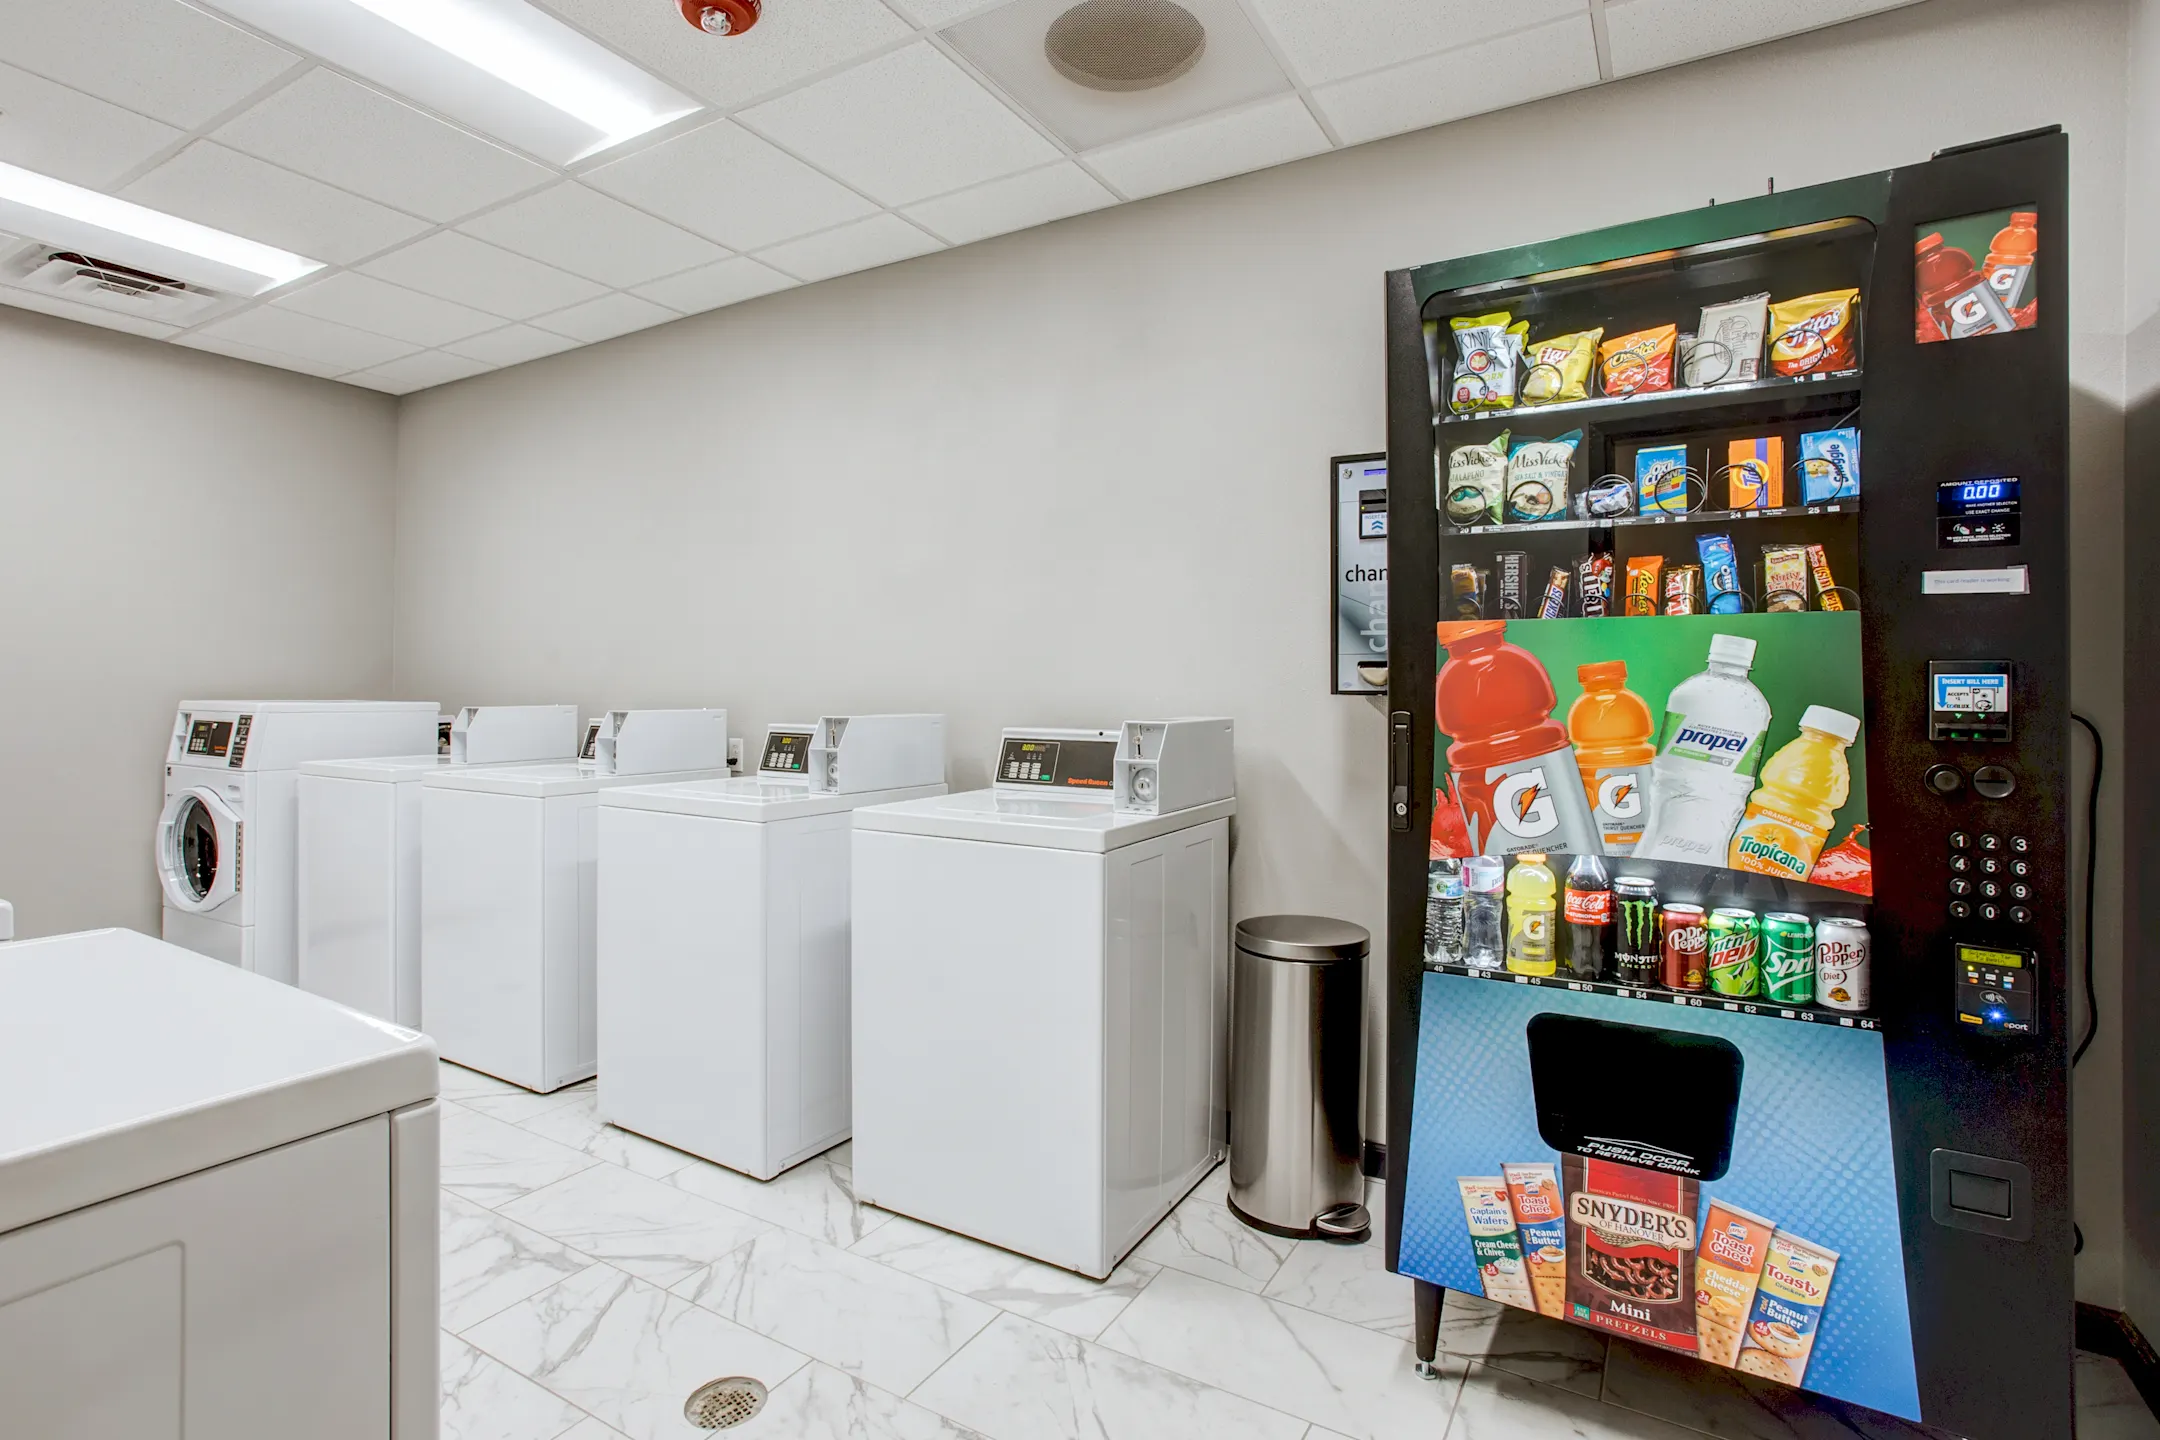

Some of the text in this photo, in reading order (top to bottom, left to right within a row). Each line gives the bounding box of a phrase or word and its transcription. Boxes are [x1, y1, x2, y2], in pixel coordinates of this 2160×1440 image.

[1989, 268, 2017, 290] G
[1951, 292, 1987, 324] G
[1785, 309, 1840, 348] Fritos
[1788, 361, 1799, 369] The
[1800, 345, 1838, 366] ORIGINAL
[1827, 443, 1849, 483] Snuggle
[1742, 462, 1759, 486] Tide
[1675, 728, 1748, 752] propel
[1088, 778, 1108, 786] Queen
[1493, 766, 1560, 838] G
[1598, 773, 1642, 819] G
[1762, 808, 1814, 832] ORANGE JUICE
[1956, 835, 2027, 851] 1 2 3
[1738, 836, 1806, 875] Tropicana
[1740, 855, 1764, 869] 100%
[1955, 858, 2026, 875] 4 5 6
[1565, 891, 1606, 910] Coca-Cola
[1956, 882, 2026, 898] 7 8 9
[1986, 906, 1995, 919] 0
[1523, 914, 1545, 940] G
[1686, 926, 1703, 938] Dr
[1818, 943, 1863, 967] Pepper
[1831, 941, 1851, 953] Dr
[1530, 977, 1541, 985] 45
[1823, 972, 1841, 980] Diet
[1582, 984, 1593, 992] 50
[1690, 998, 1702, 1006] 60
[1744, 1005, 1757, 1014] 62
[1801, 1012, 1814, 1021] 63
[1860, 1020, 1874, 1029] 64
[1577, 1145, 1701, 1175] TO RETRIEVE DRINK
[1587, 1142, 1690, 1167] PUSH DOOR
[1518, 1195, 1549, 1205] Toast
[1520, 1204, 1550, 1214] Chee
[1470, 1207, 1507, 1216] Captain's
[1472, 1215, 1509, 1226] Wafers
[1577, 1198, 1688, 1239] SNYDER'S
[1530, 1228, 1561, 1238] Peanut
[1599, 1219, 1664, 1242] OF HANOVER
[1474, 1240, 1520, 1250] Cream Cheese
[1531, 1237, 1560, 1246] Butter
[1713, 1230, 1754, 1256] Toast
[1477, 1248, 1506, 1257] & Chives
[1710, 1242, 1750, 1264] Chee
[1704, 1277, 1741, 1298] Cheese
[1706, 1269, 1751, 1292] Cheddar
[1766, 1263, 1820, 1296] Toasty
[1610, 1300, 1652, 1321] Mini
[1766, 1308, 1803, 1329] Butter
[1768, 1299, 1809, 1324] Peanut
[1596, 1314, 1667, 1341] PRETZELS
